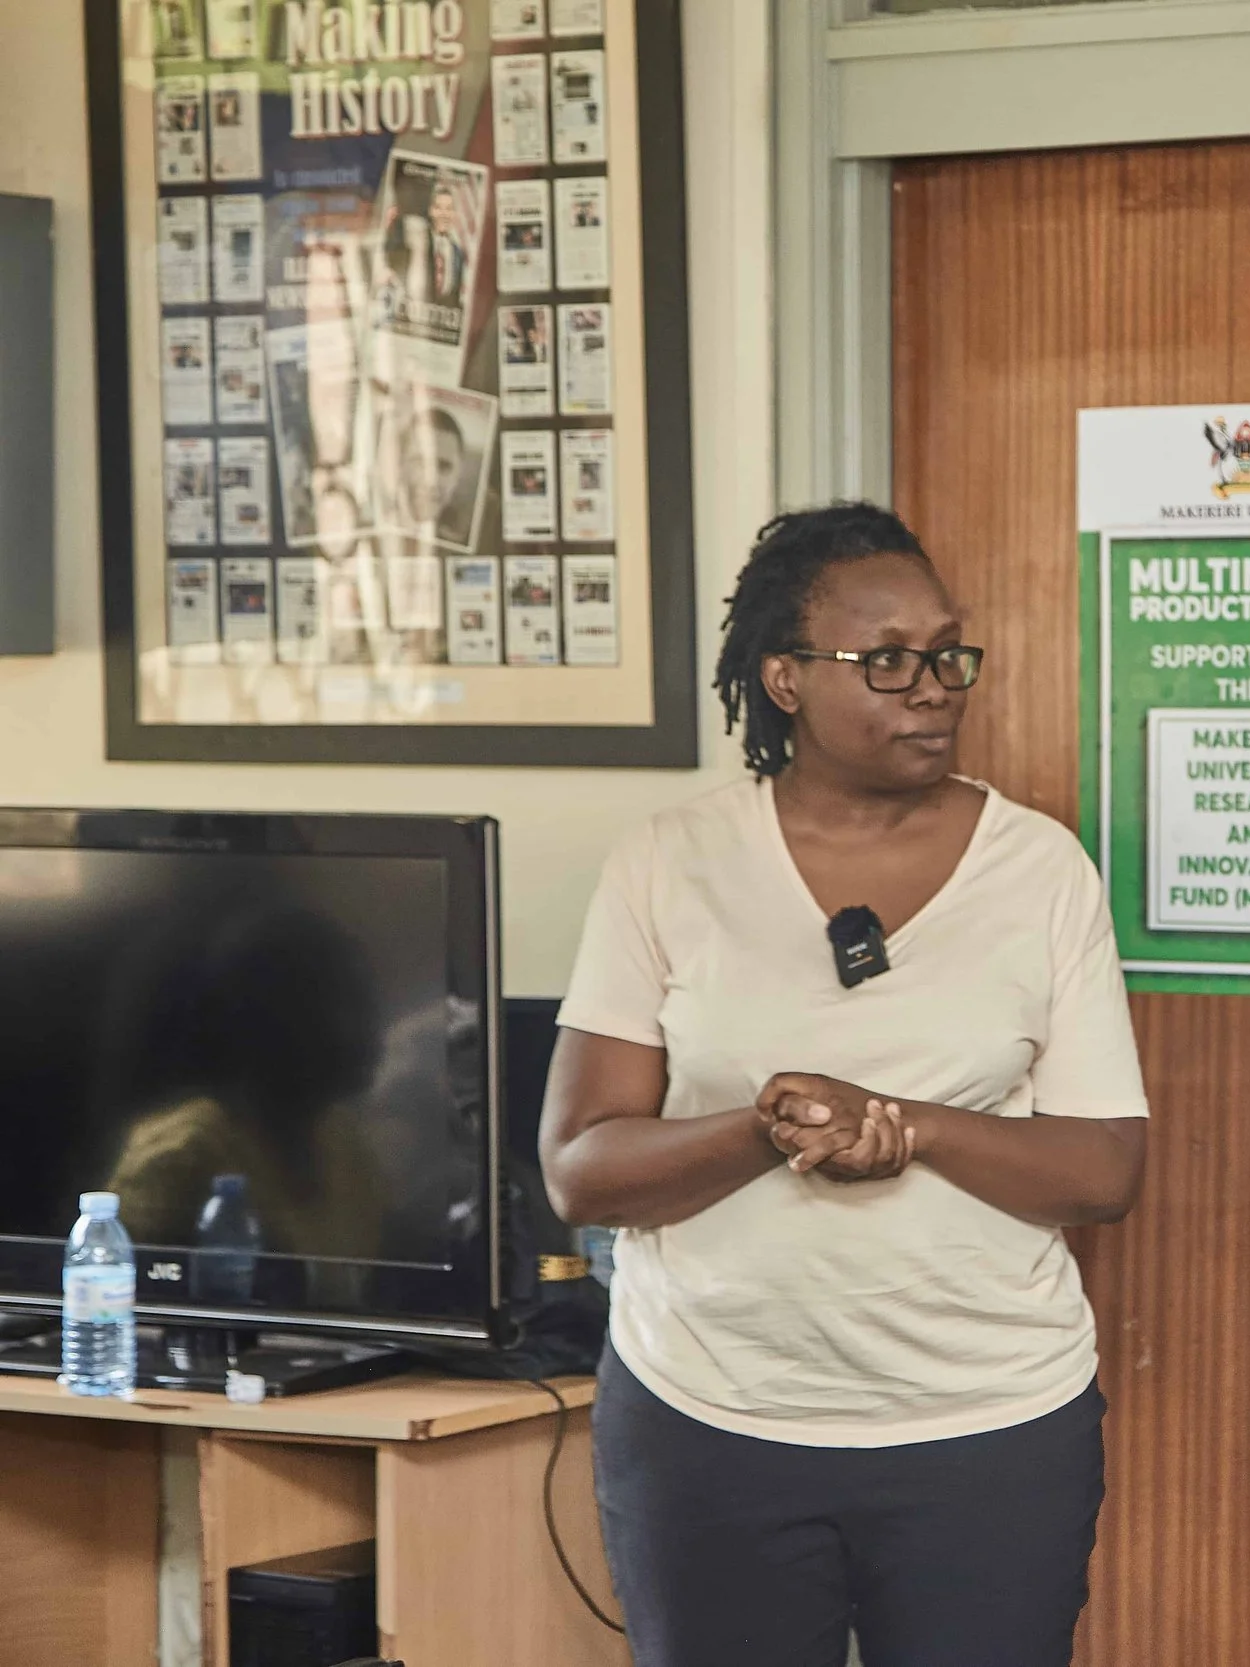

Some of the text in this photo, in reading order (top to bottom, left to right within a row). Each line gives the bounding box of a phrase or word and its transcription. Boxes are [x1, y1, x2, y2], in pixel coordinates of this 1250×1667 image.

[284, 0, 465, 66] Making
[289, 67, 461, 139] History
[1159, 504, 1242, 520] MAKERERE
[1170, 887, 1227, 905] FUND
[147, 1263, 182, 1280] JVC
